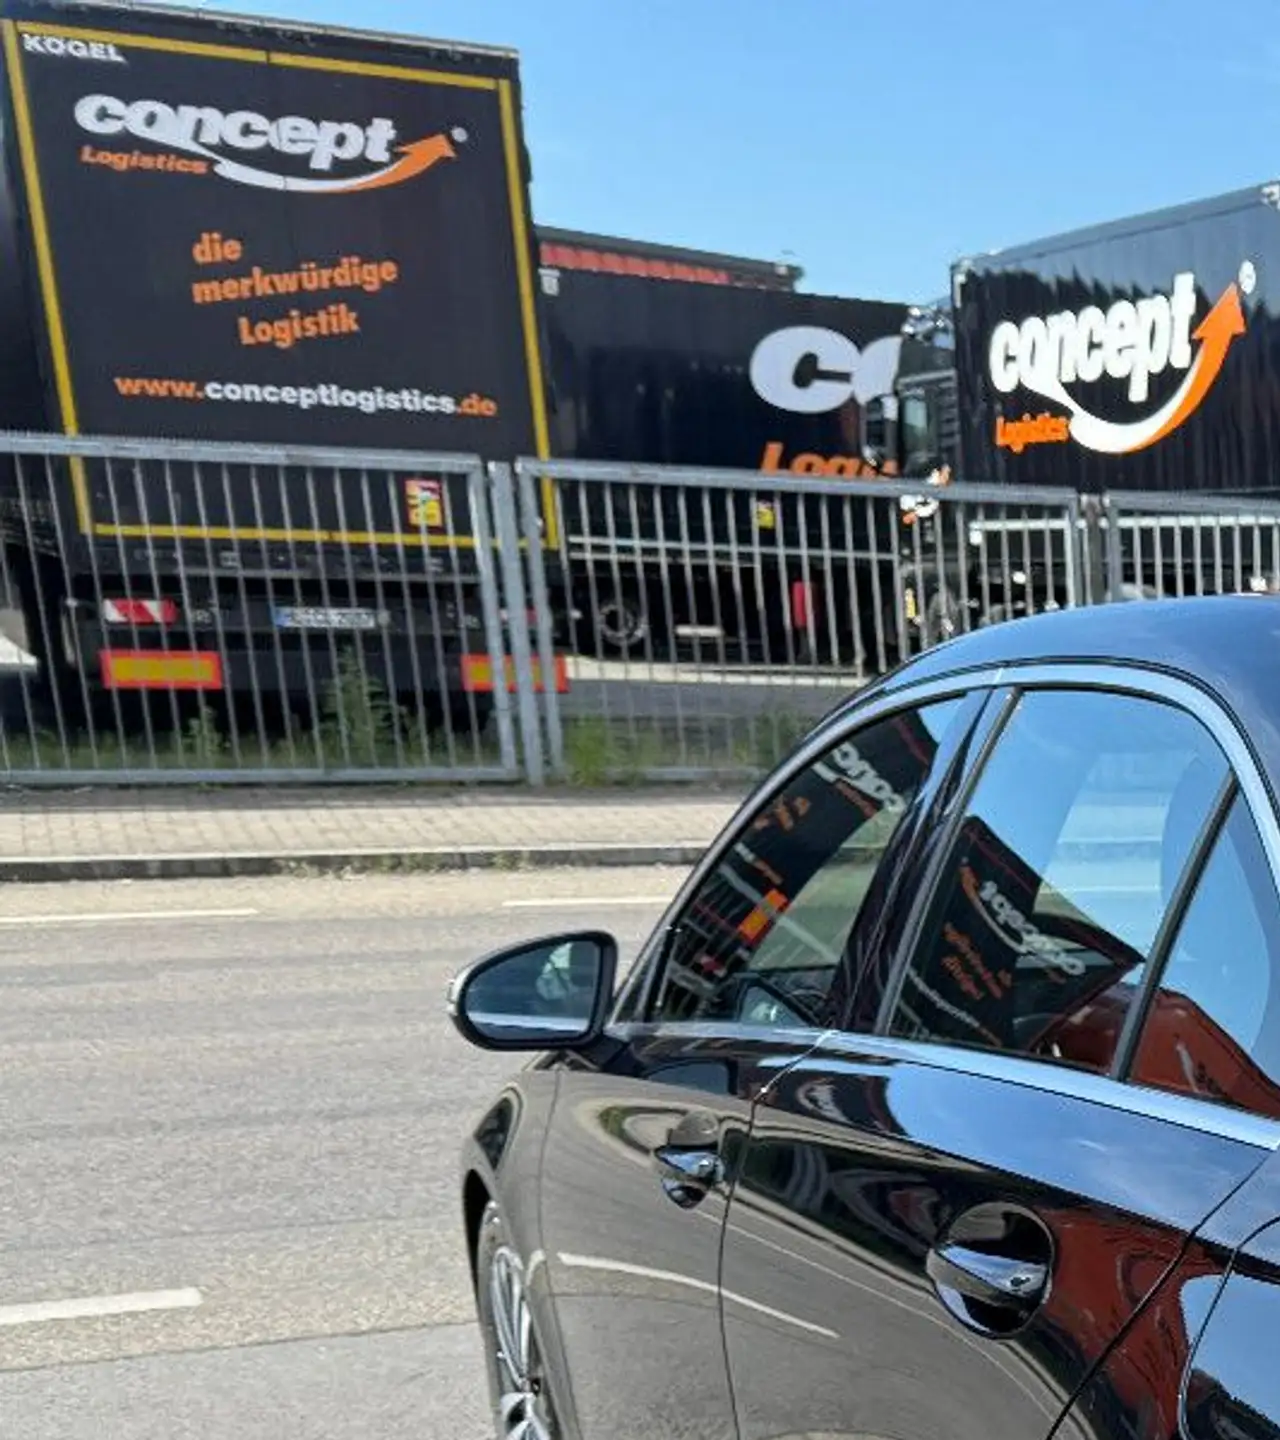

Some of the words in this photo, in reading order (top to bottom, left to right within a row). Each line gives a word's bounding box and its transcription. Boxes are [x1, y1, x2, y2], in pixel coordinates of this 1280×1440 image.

[74, 93, 397, 171] concept
[80, 146, 209, 175] Logistics
[192, 232, 243, 263] die
[192, 256, 398, 305] merkwürdige
[238, 303, 361, 349] Logistik
[989, 271, 1196, 403] concept
[114, 376, 499, 417] www.conceptlogistics.de
